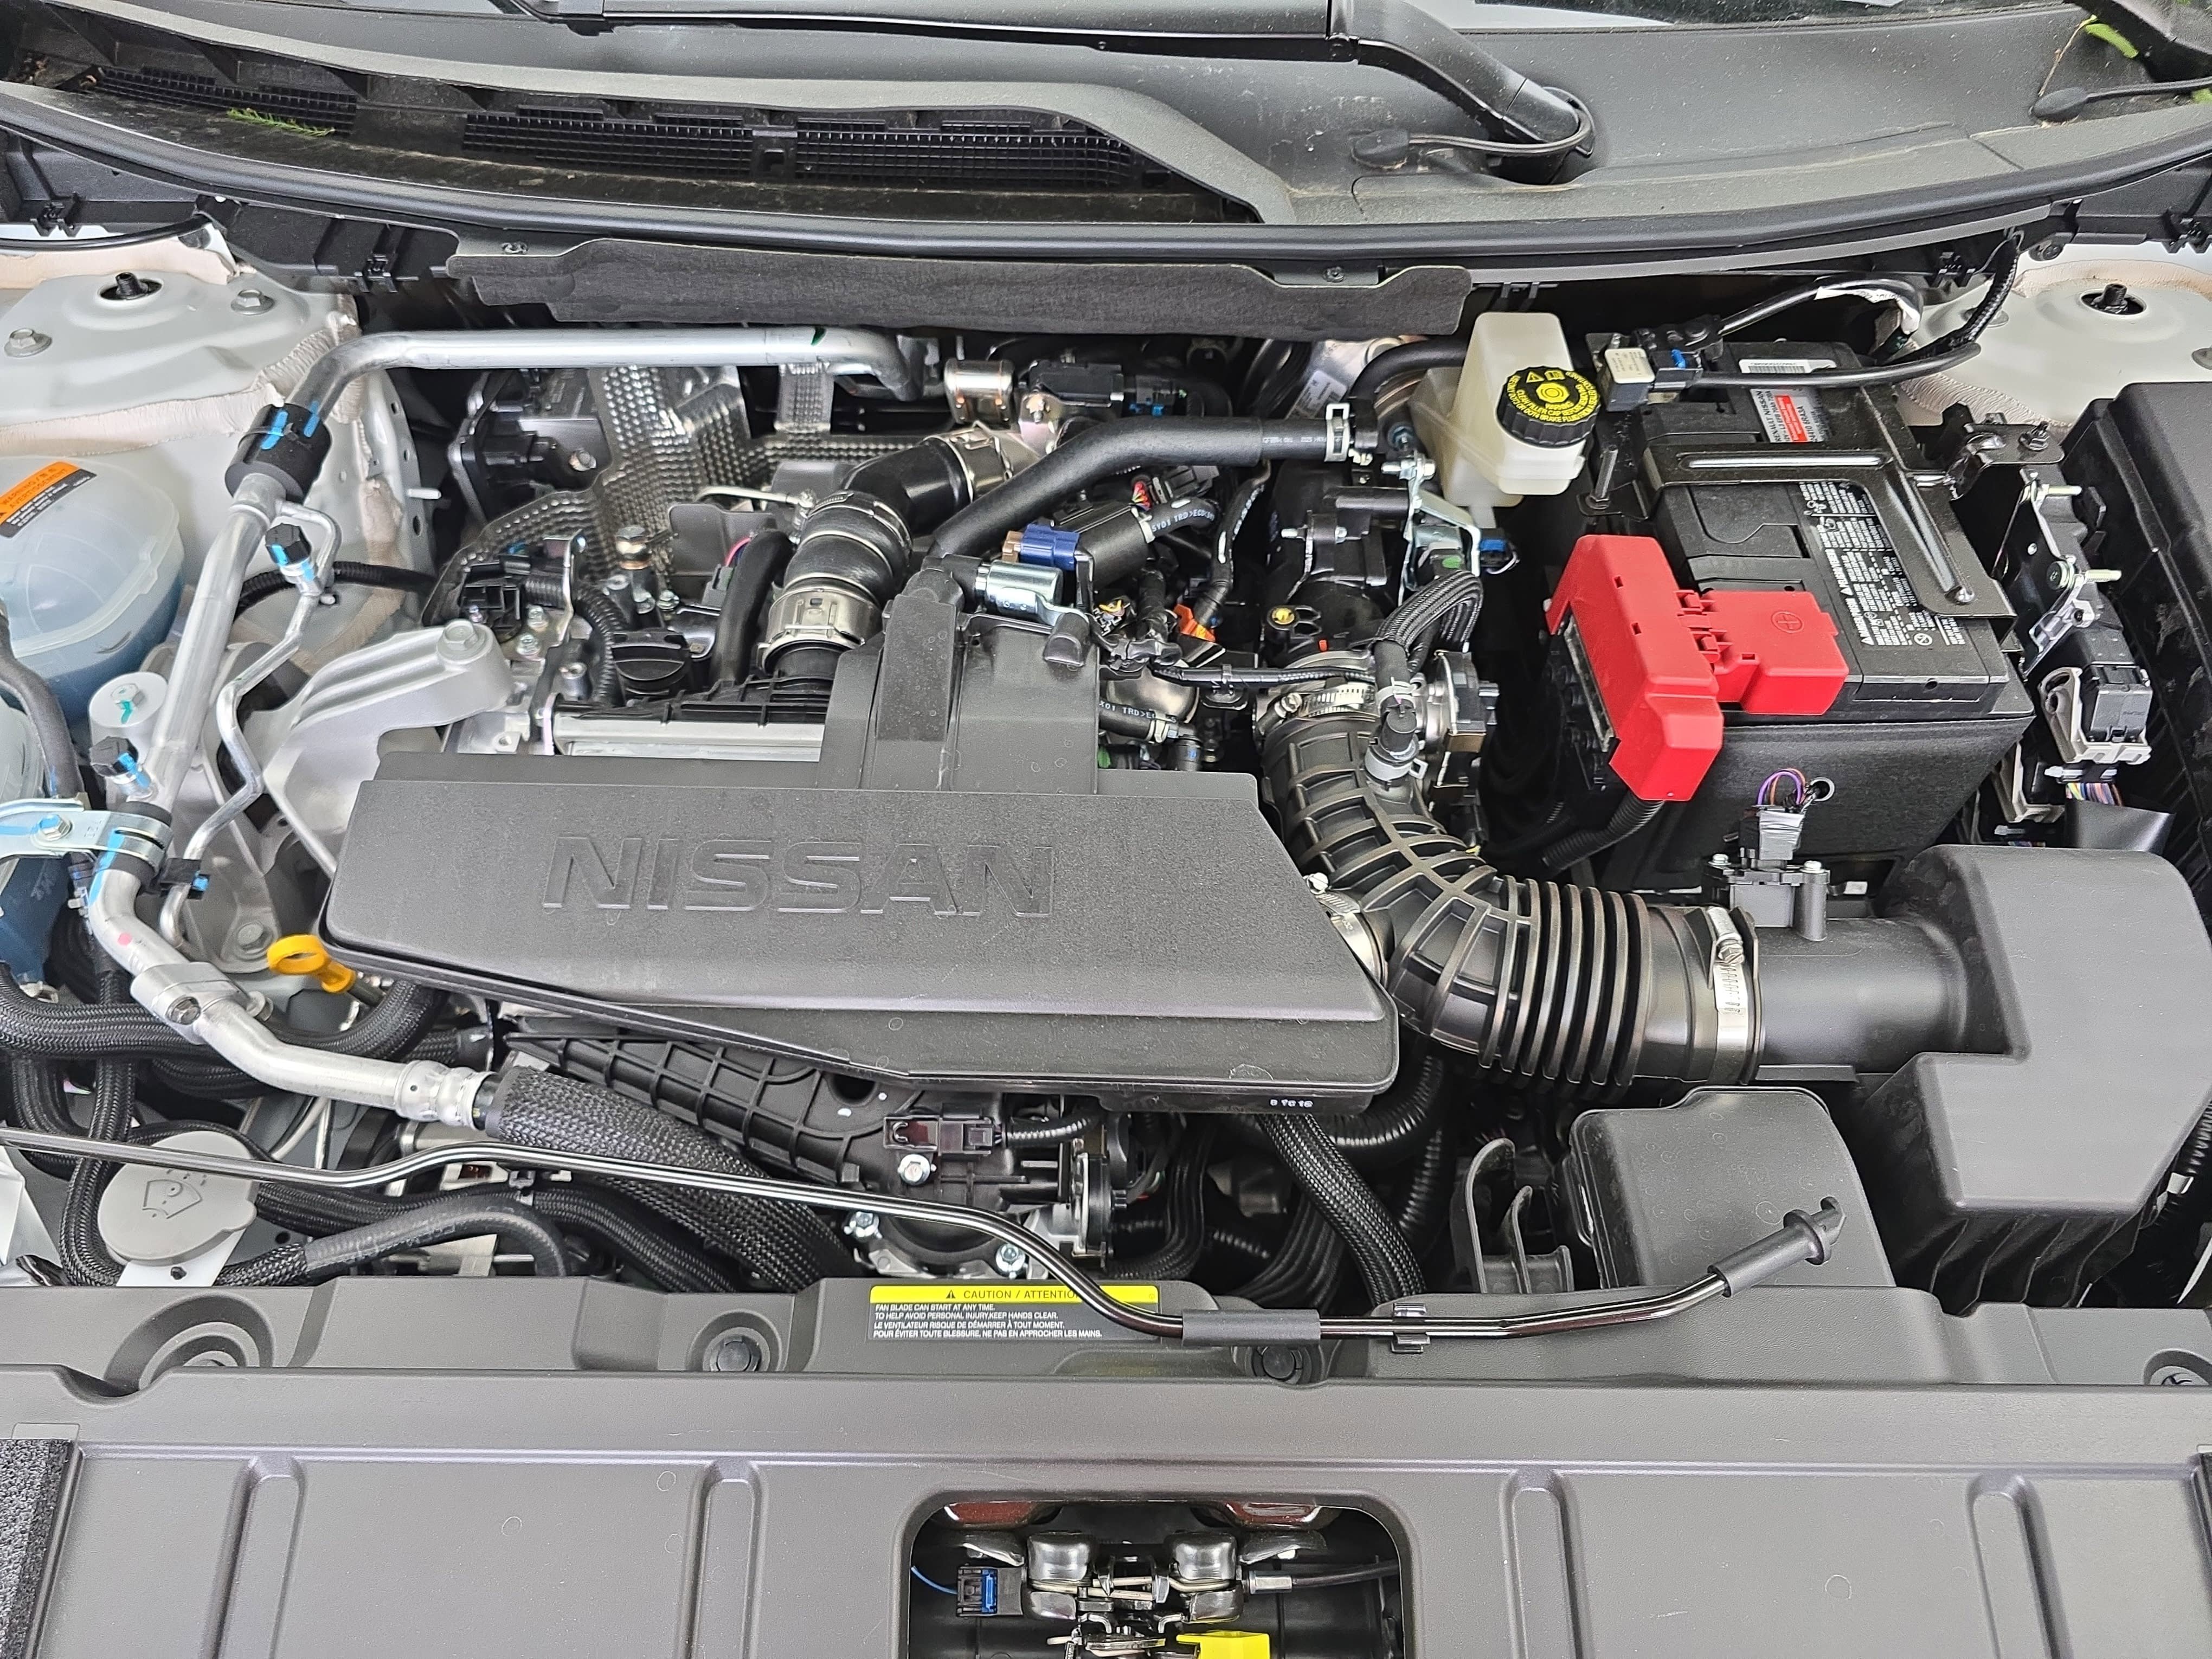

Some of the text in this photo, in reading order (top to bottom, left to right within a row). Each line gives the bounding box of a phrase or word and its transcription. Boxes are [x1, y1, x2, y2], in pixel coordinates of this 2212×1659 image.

[1516, 390, 1532, 404] CLEAN
[1526, 402, 1547, 414] FILLER
[1523, 408, 1540, 419] DOT4
[1539, 414, 1562, 422] BRAKE
[1756, 390, 1782, 442] RENAULT NISSAN
[542, 835, 1055, 919] NISSAN
[963, 1290, 1079, 1299] CAUTION / ATTENTIO
[875, 1311, 885, 1320] TO
[886, 1311, 904, 1320] HELP
[904, 1311, 926, 1320] AVOID
[927, 1311, 964, 1320] PERSONAL
[1008, 1311, 1033, 1320] HANDS
[1034, 1311, 1058, 1320] CLEAR.
[968, 1320, 1004, 1329] DÉMARRER
[895, 1328, 918, 1338] ÉVITER
